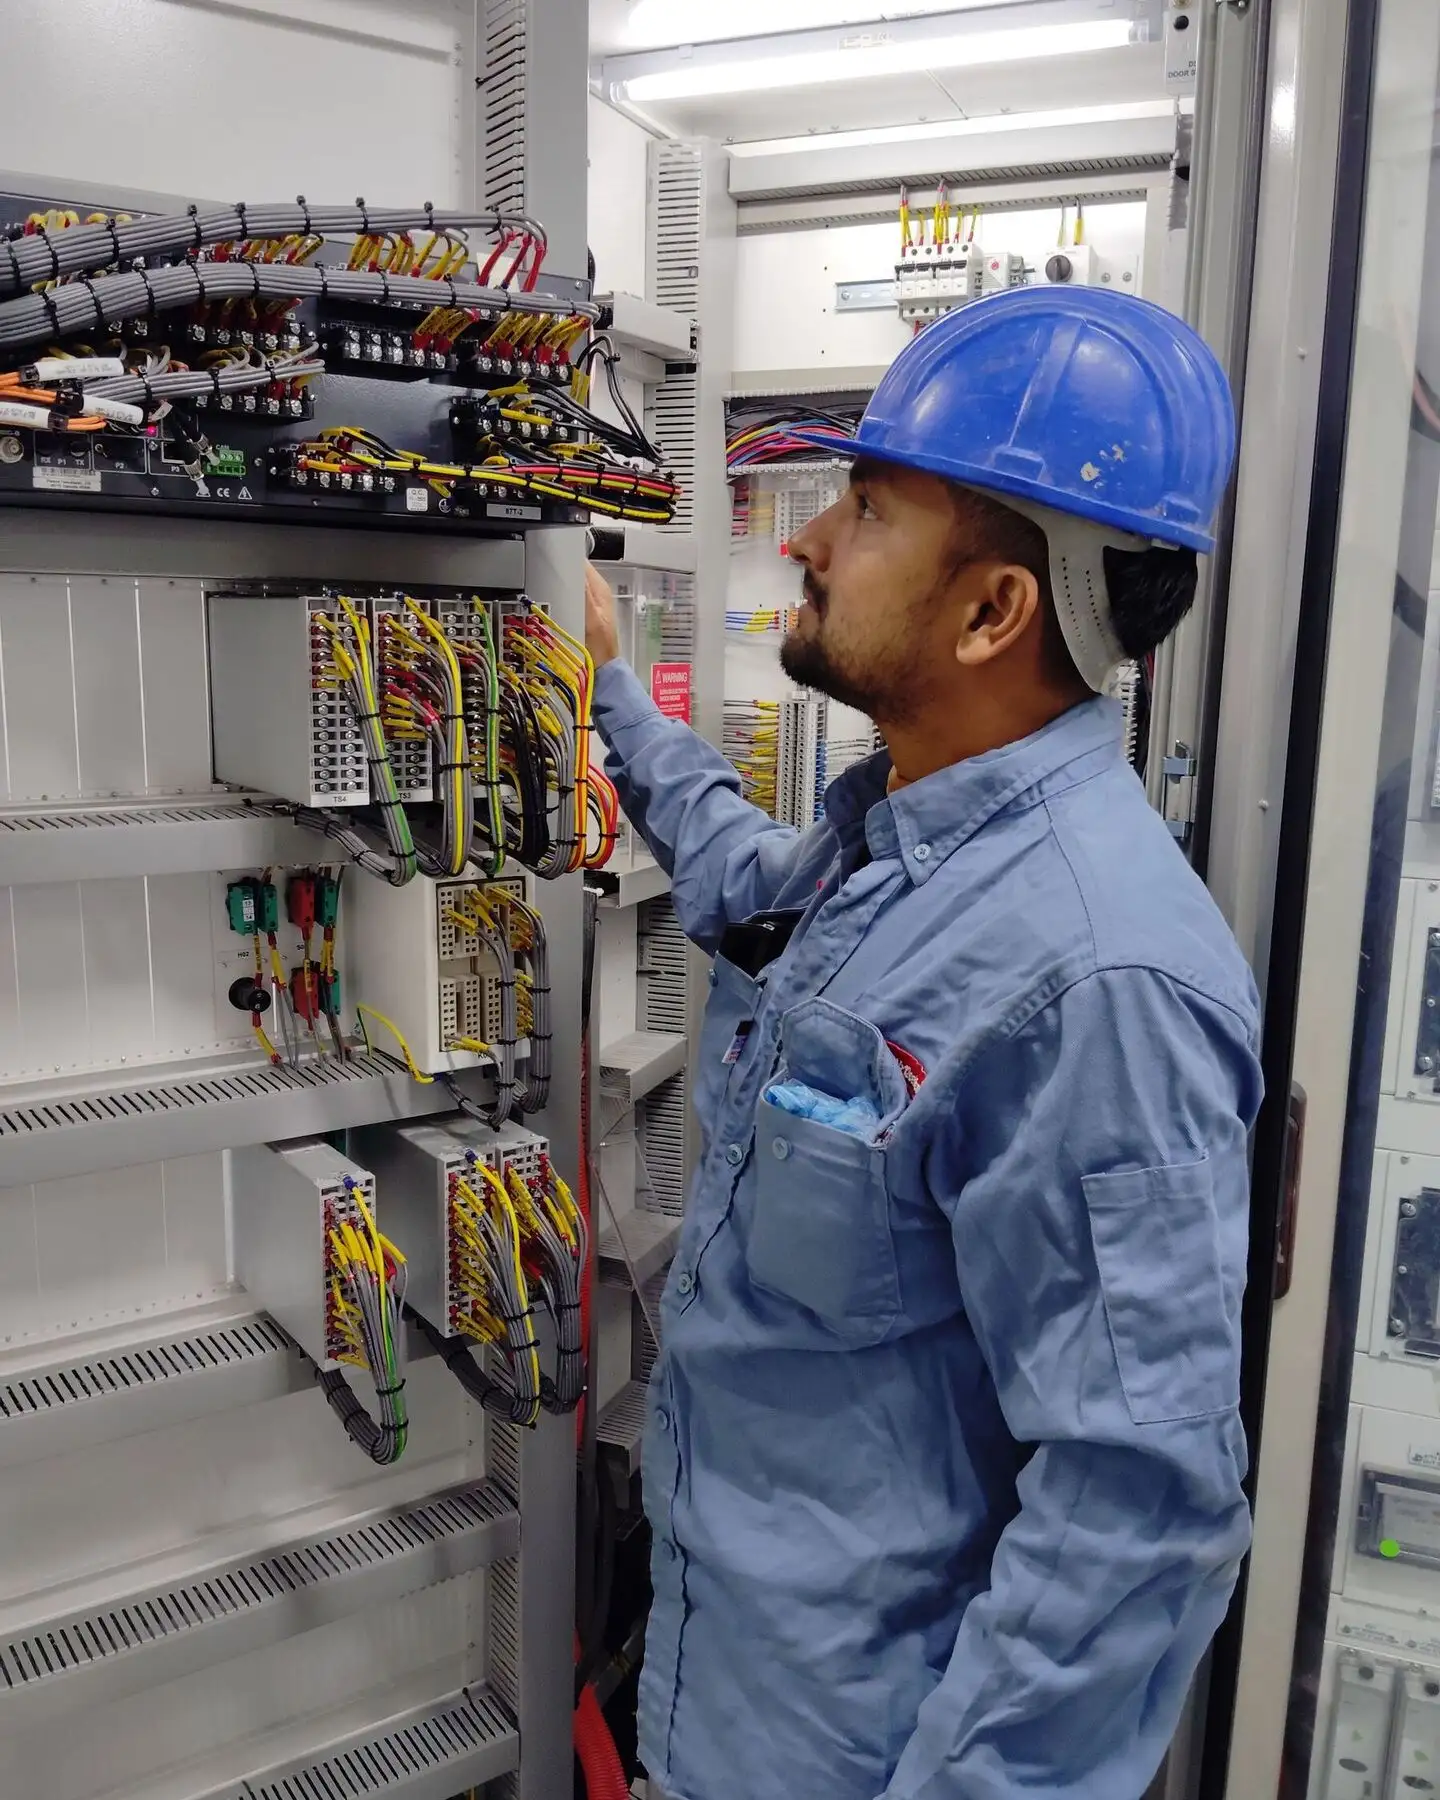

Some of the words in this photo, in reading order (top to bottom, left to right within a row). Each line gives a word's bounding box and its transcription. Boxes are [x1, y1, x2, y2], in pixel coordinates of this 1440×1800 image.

[1168, 70, 1190, 78] DOOR
[40, 456, 52, 464] RX
[57, 458, 67, 466] P1
[170, 465, 180, 473] P3
[661, 671, 688, 684] WARNING
[332, 795, 347, 803] TS4
